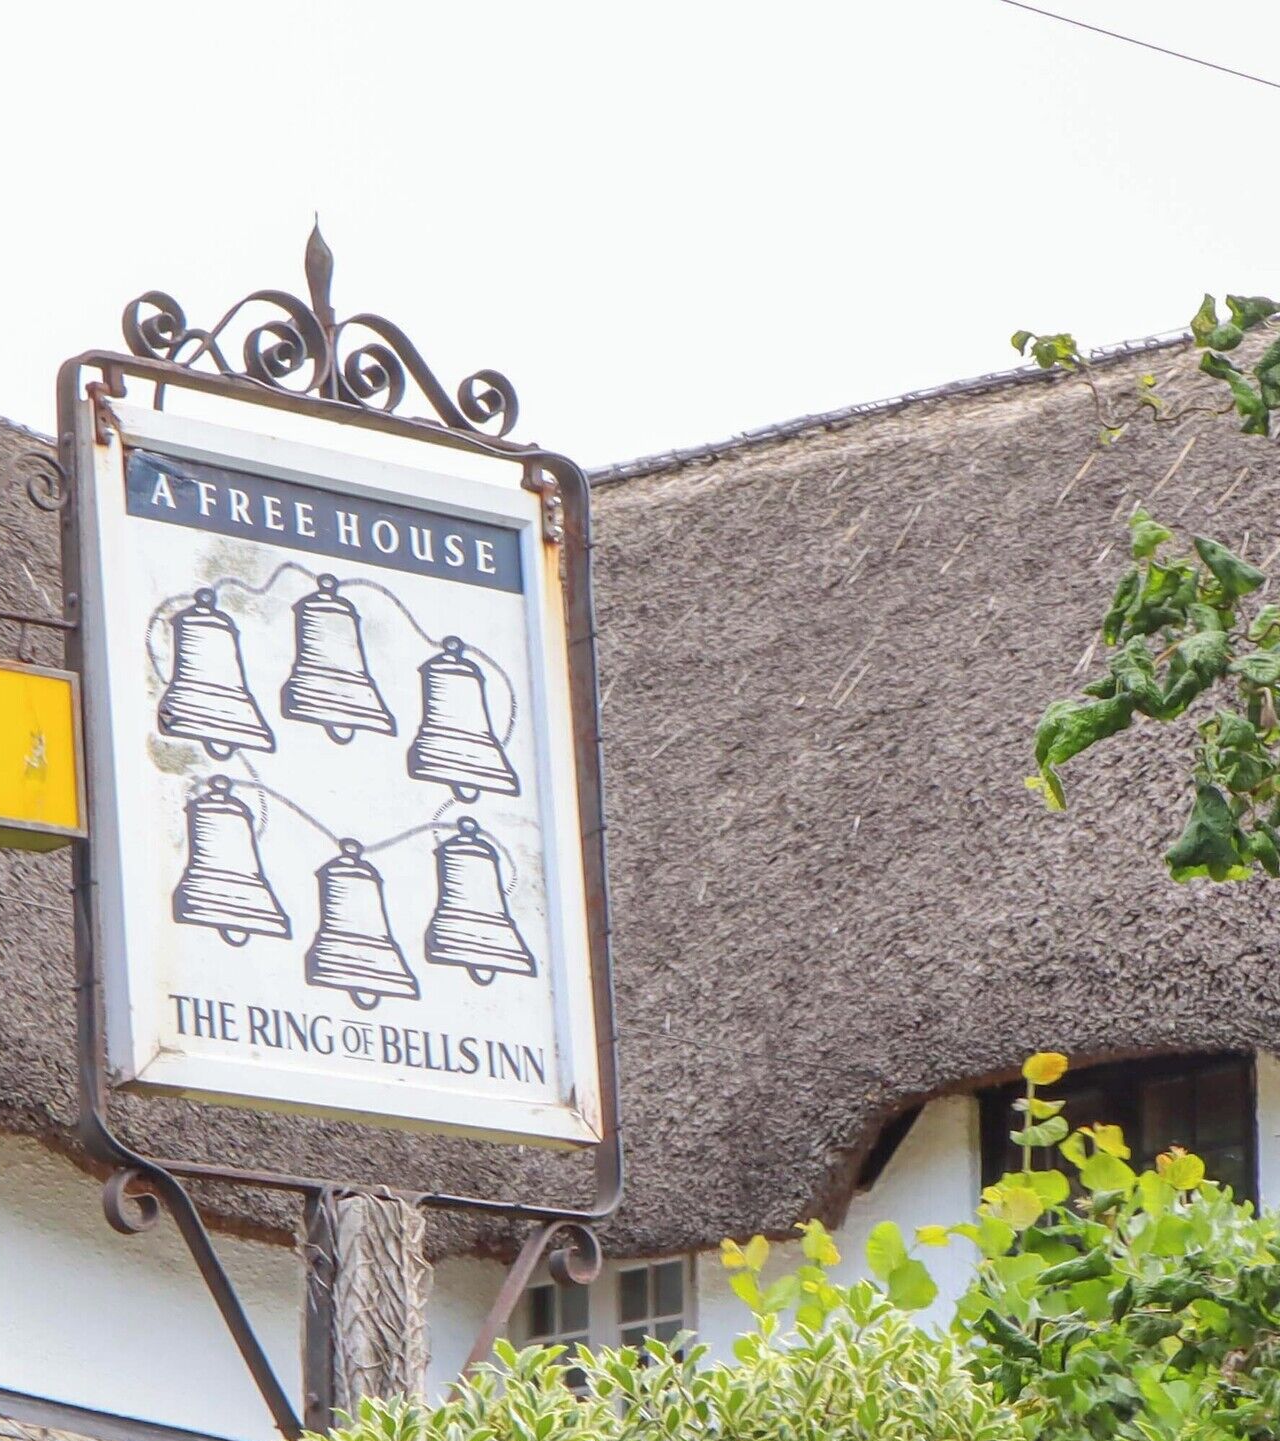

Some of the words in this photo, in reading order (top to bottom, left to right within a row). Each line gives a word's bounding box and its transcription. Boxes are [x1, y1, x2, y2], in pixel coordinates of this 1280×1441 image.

[151, 473, 177, 509] A
[193, 479, 317, 538] FREE
[334, 510, 497, 575] HOUSE
[168, 994, 239, 1043] THE
[247, 1005, 334, 1056] RING
[341, 1024, 375, 1055] OF
[379, 1024, 480, 1075] BELLS
[484, 1039, 546, 1085] INN
